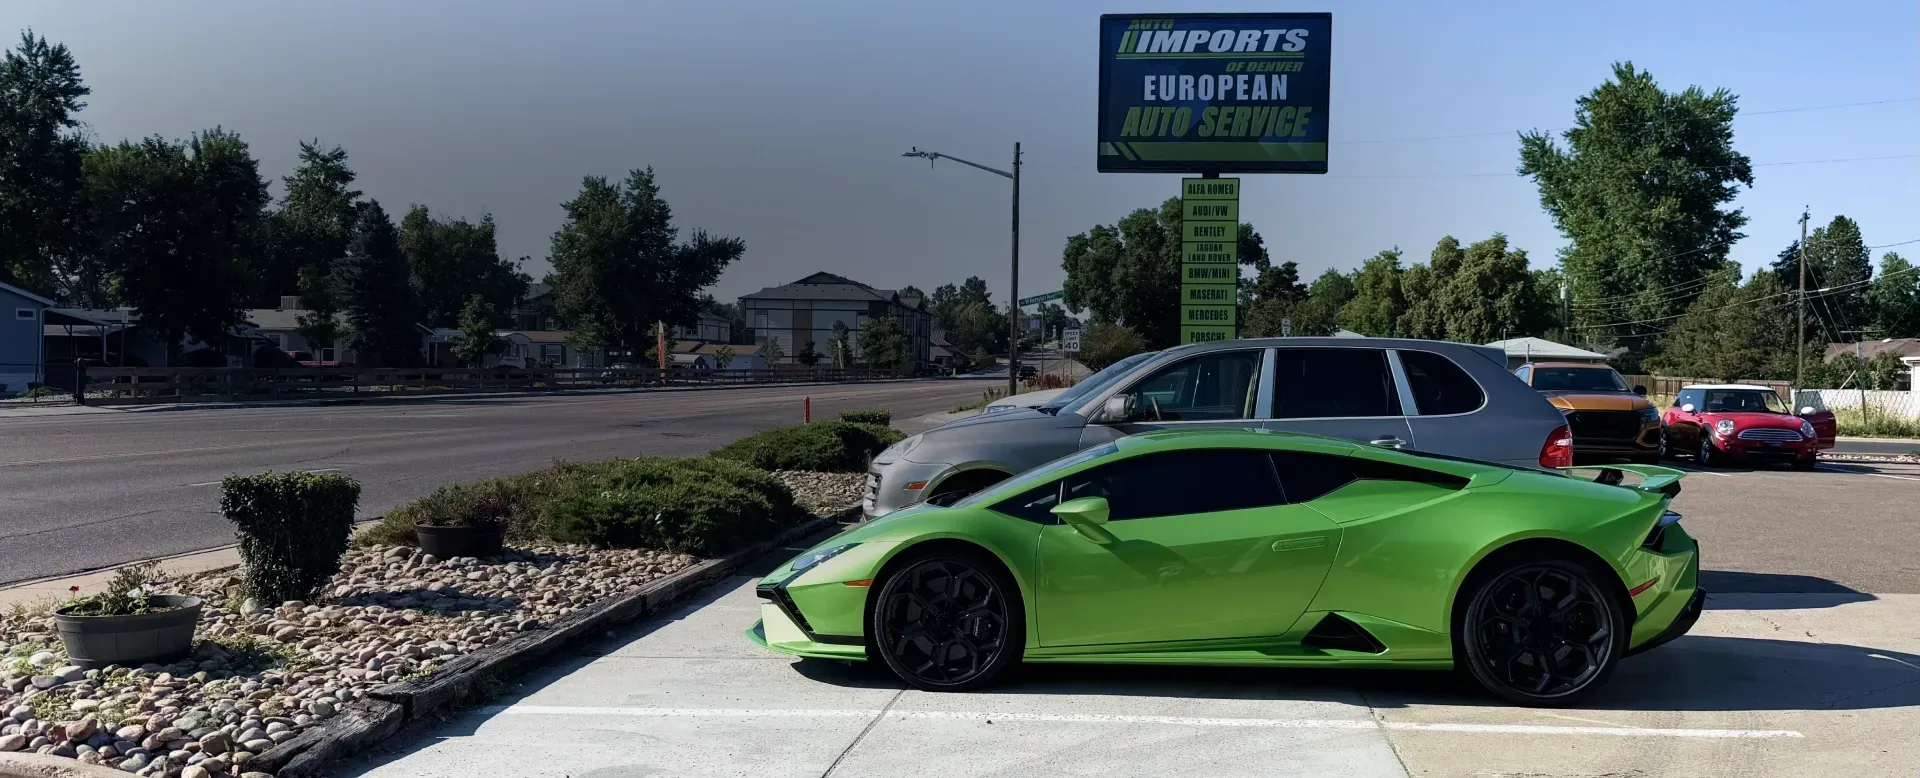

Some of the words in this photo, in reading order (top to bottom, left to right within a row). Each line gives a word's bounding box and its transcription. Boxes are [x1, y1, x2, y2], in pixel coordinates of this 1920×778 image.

[1128, 19, 1174, 30] AUTO
[1135, 29, 1309, 53] IMPORTS
[1226, 61, 1244, 72] OF
[1246, 61, 1304, 72] DENVER
[1144, 74, 1288, 101] EUROPEAN
[1120, 106, 1193, 137] AUTO
[1198, 106, 1312, 137] SERVICE
[1187, 183, 1206, 195] ALFA
[1207, 183, 1234, 195] ROMEO
[1192, 205, 1228, 217] AUDI/VW
[1194, 226, 1226, 237] BENTLEY
[1196, 243, 1223, 252] JAGUAR
[1188, 253, 1206, 262] LAND
[1208, 253, 1231, 262] ROVER
[1188, 268, 1230, 279] BMW/MINI
[1190, 289, 1228, 300] MASERATI
[1188, 310, 1229, 321] MERCEDES
[1065, 341, 1079, 349] 40
